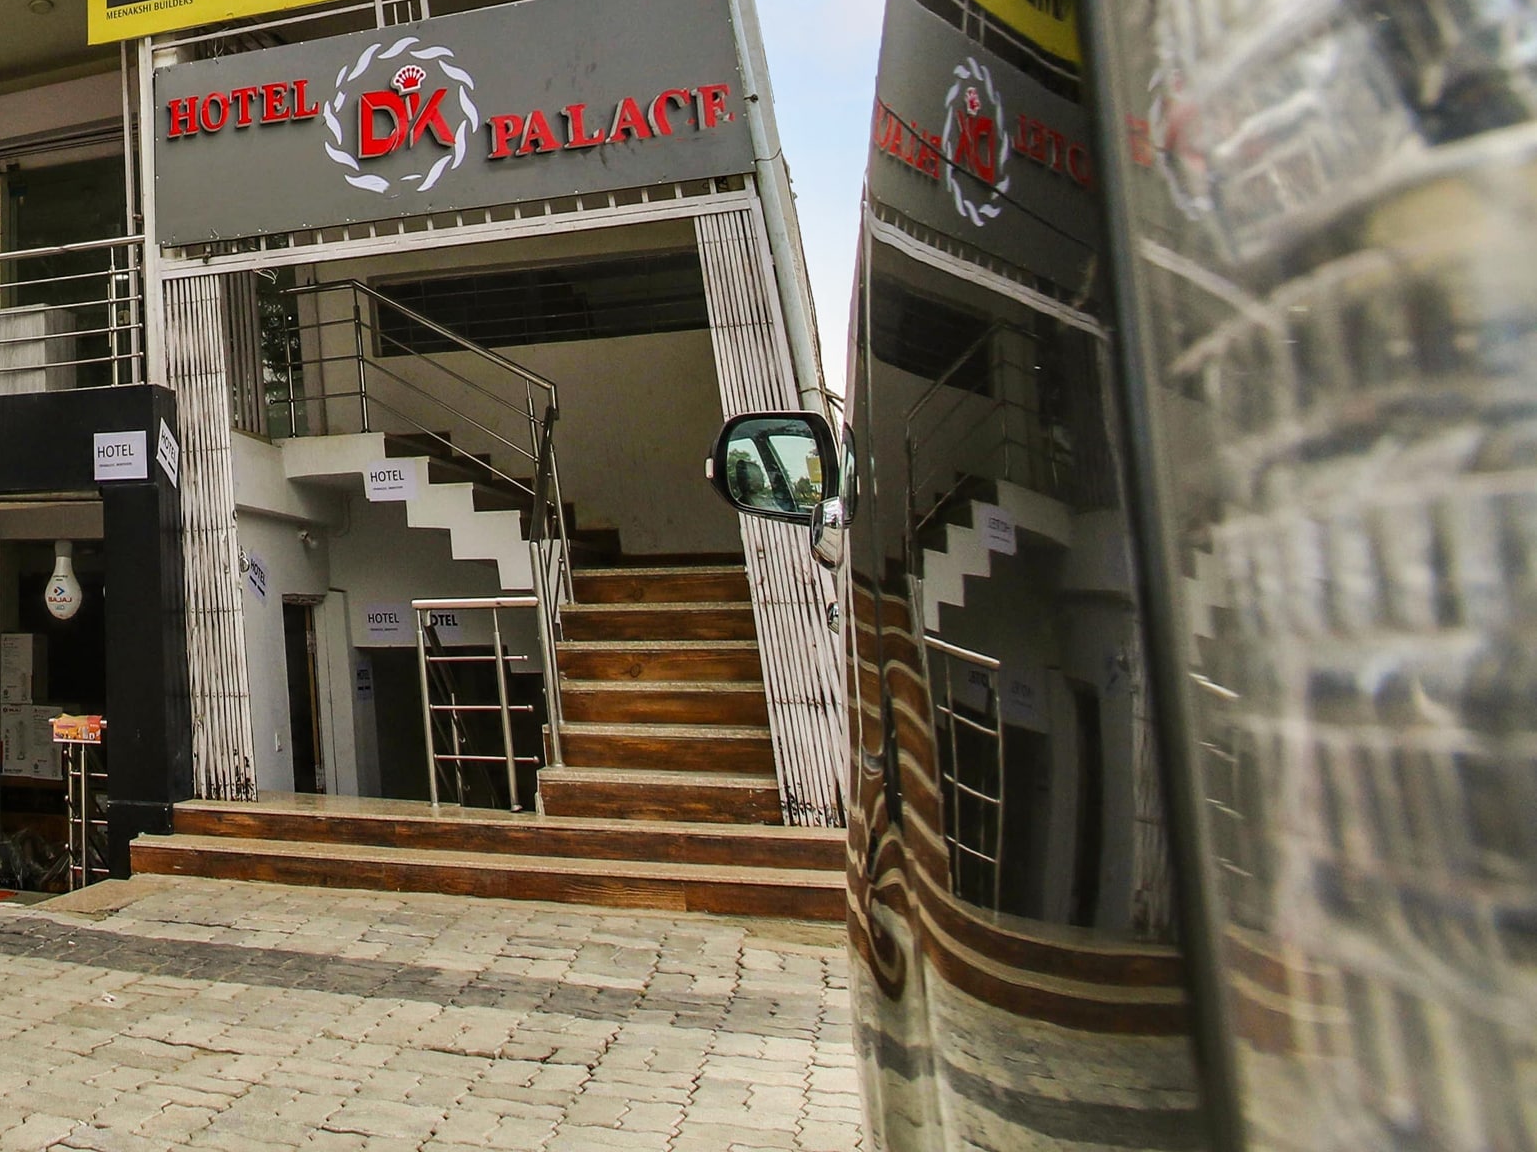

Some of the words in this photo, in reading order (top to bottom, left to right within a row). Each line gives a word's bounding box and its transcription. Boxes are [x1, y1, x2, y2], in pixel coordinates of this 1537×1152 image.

[106, 4, 152, 20] MEENAKSHI
[166, 78, 320, 139] HOTEL
[357, 87, 458, 160] DK
[97, 443, 135, 459] HOTEL
[370, 469, 405, 483] HOTEL
[368, 612, 400, 624] HOTEL
[423, 614, 459, 627] OTEL
